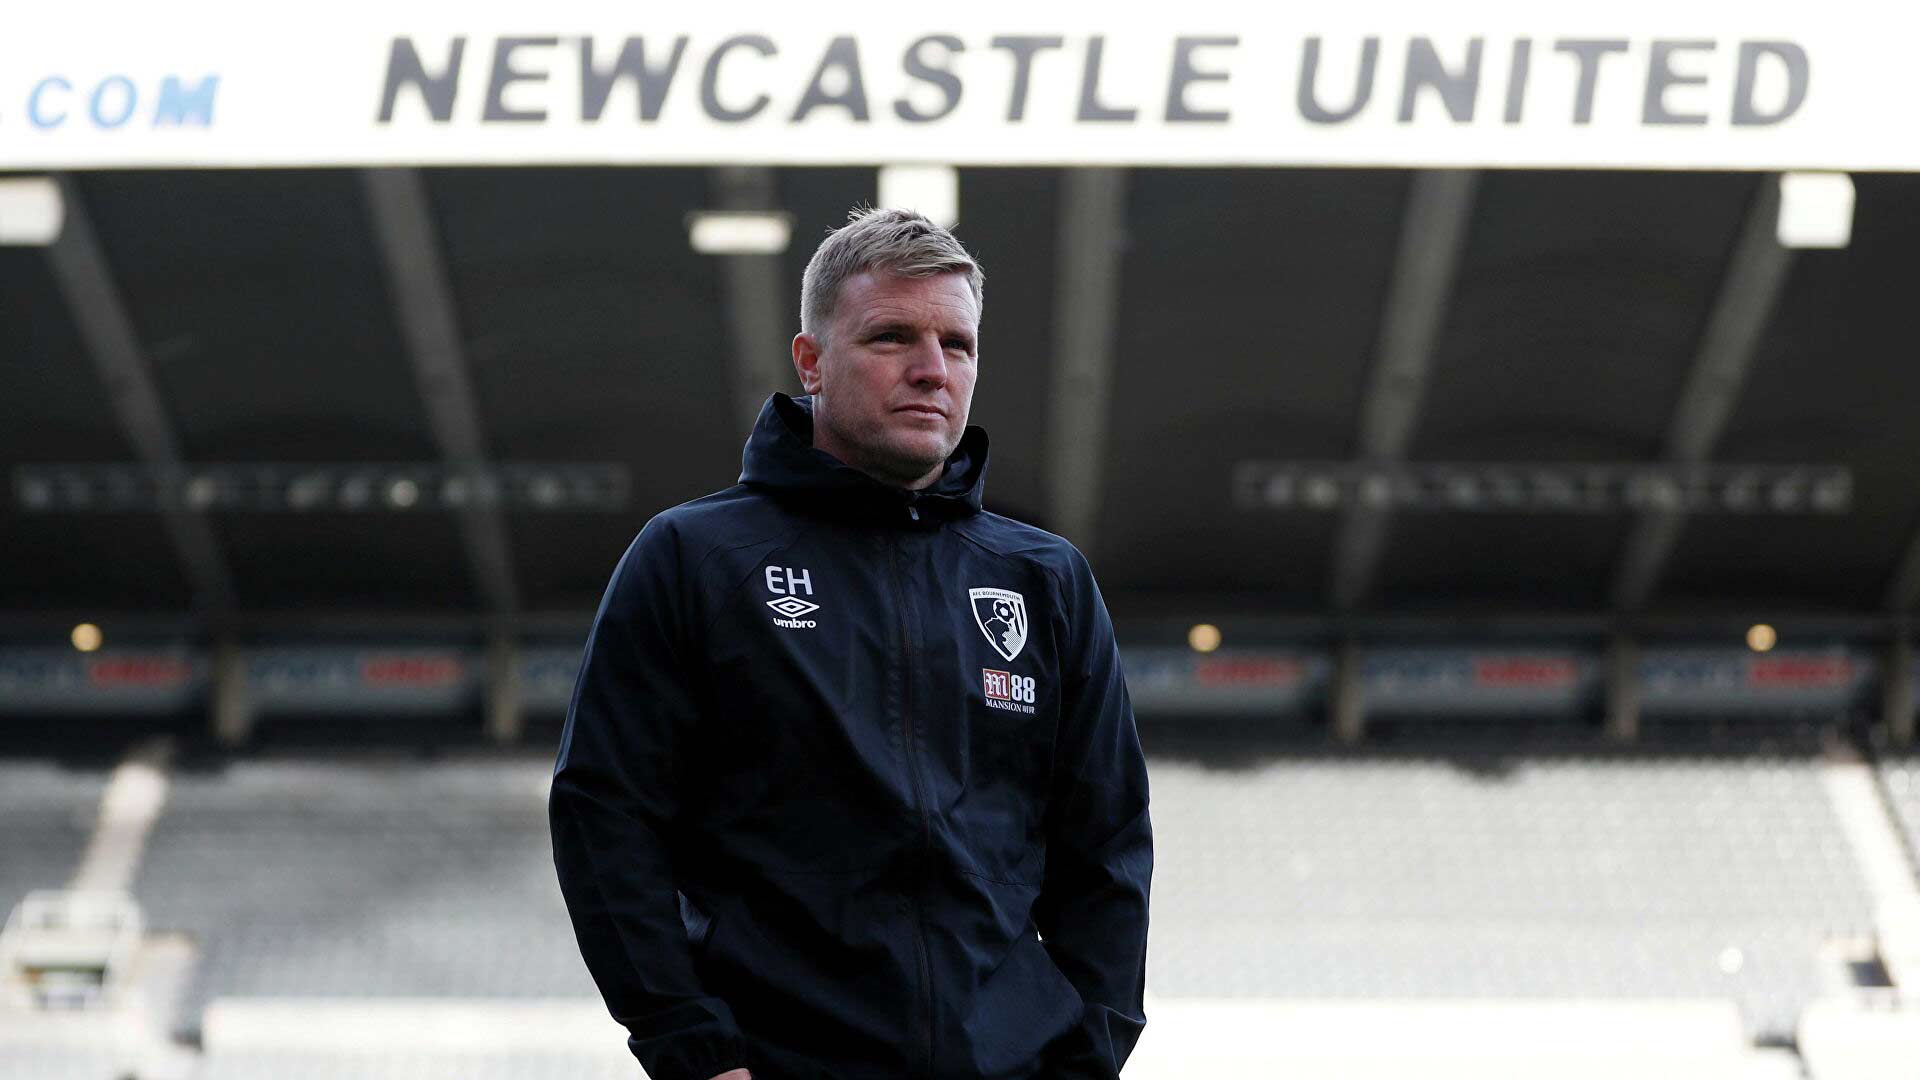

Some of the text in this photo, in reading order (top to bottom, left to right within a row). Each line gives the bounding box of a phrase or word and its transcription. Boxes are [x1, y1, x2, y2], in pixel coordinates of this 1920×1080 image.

[375, 34, 1809, 127] NEWCASTLE UNITED
[765, 565, 813, 595] EH
[773, 617, 817, 629] umbro
[985, 698, 1022, 713] MANSION
